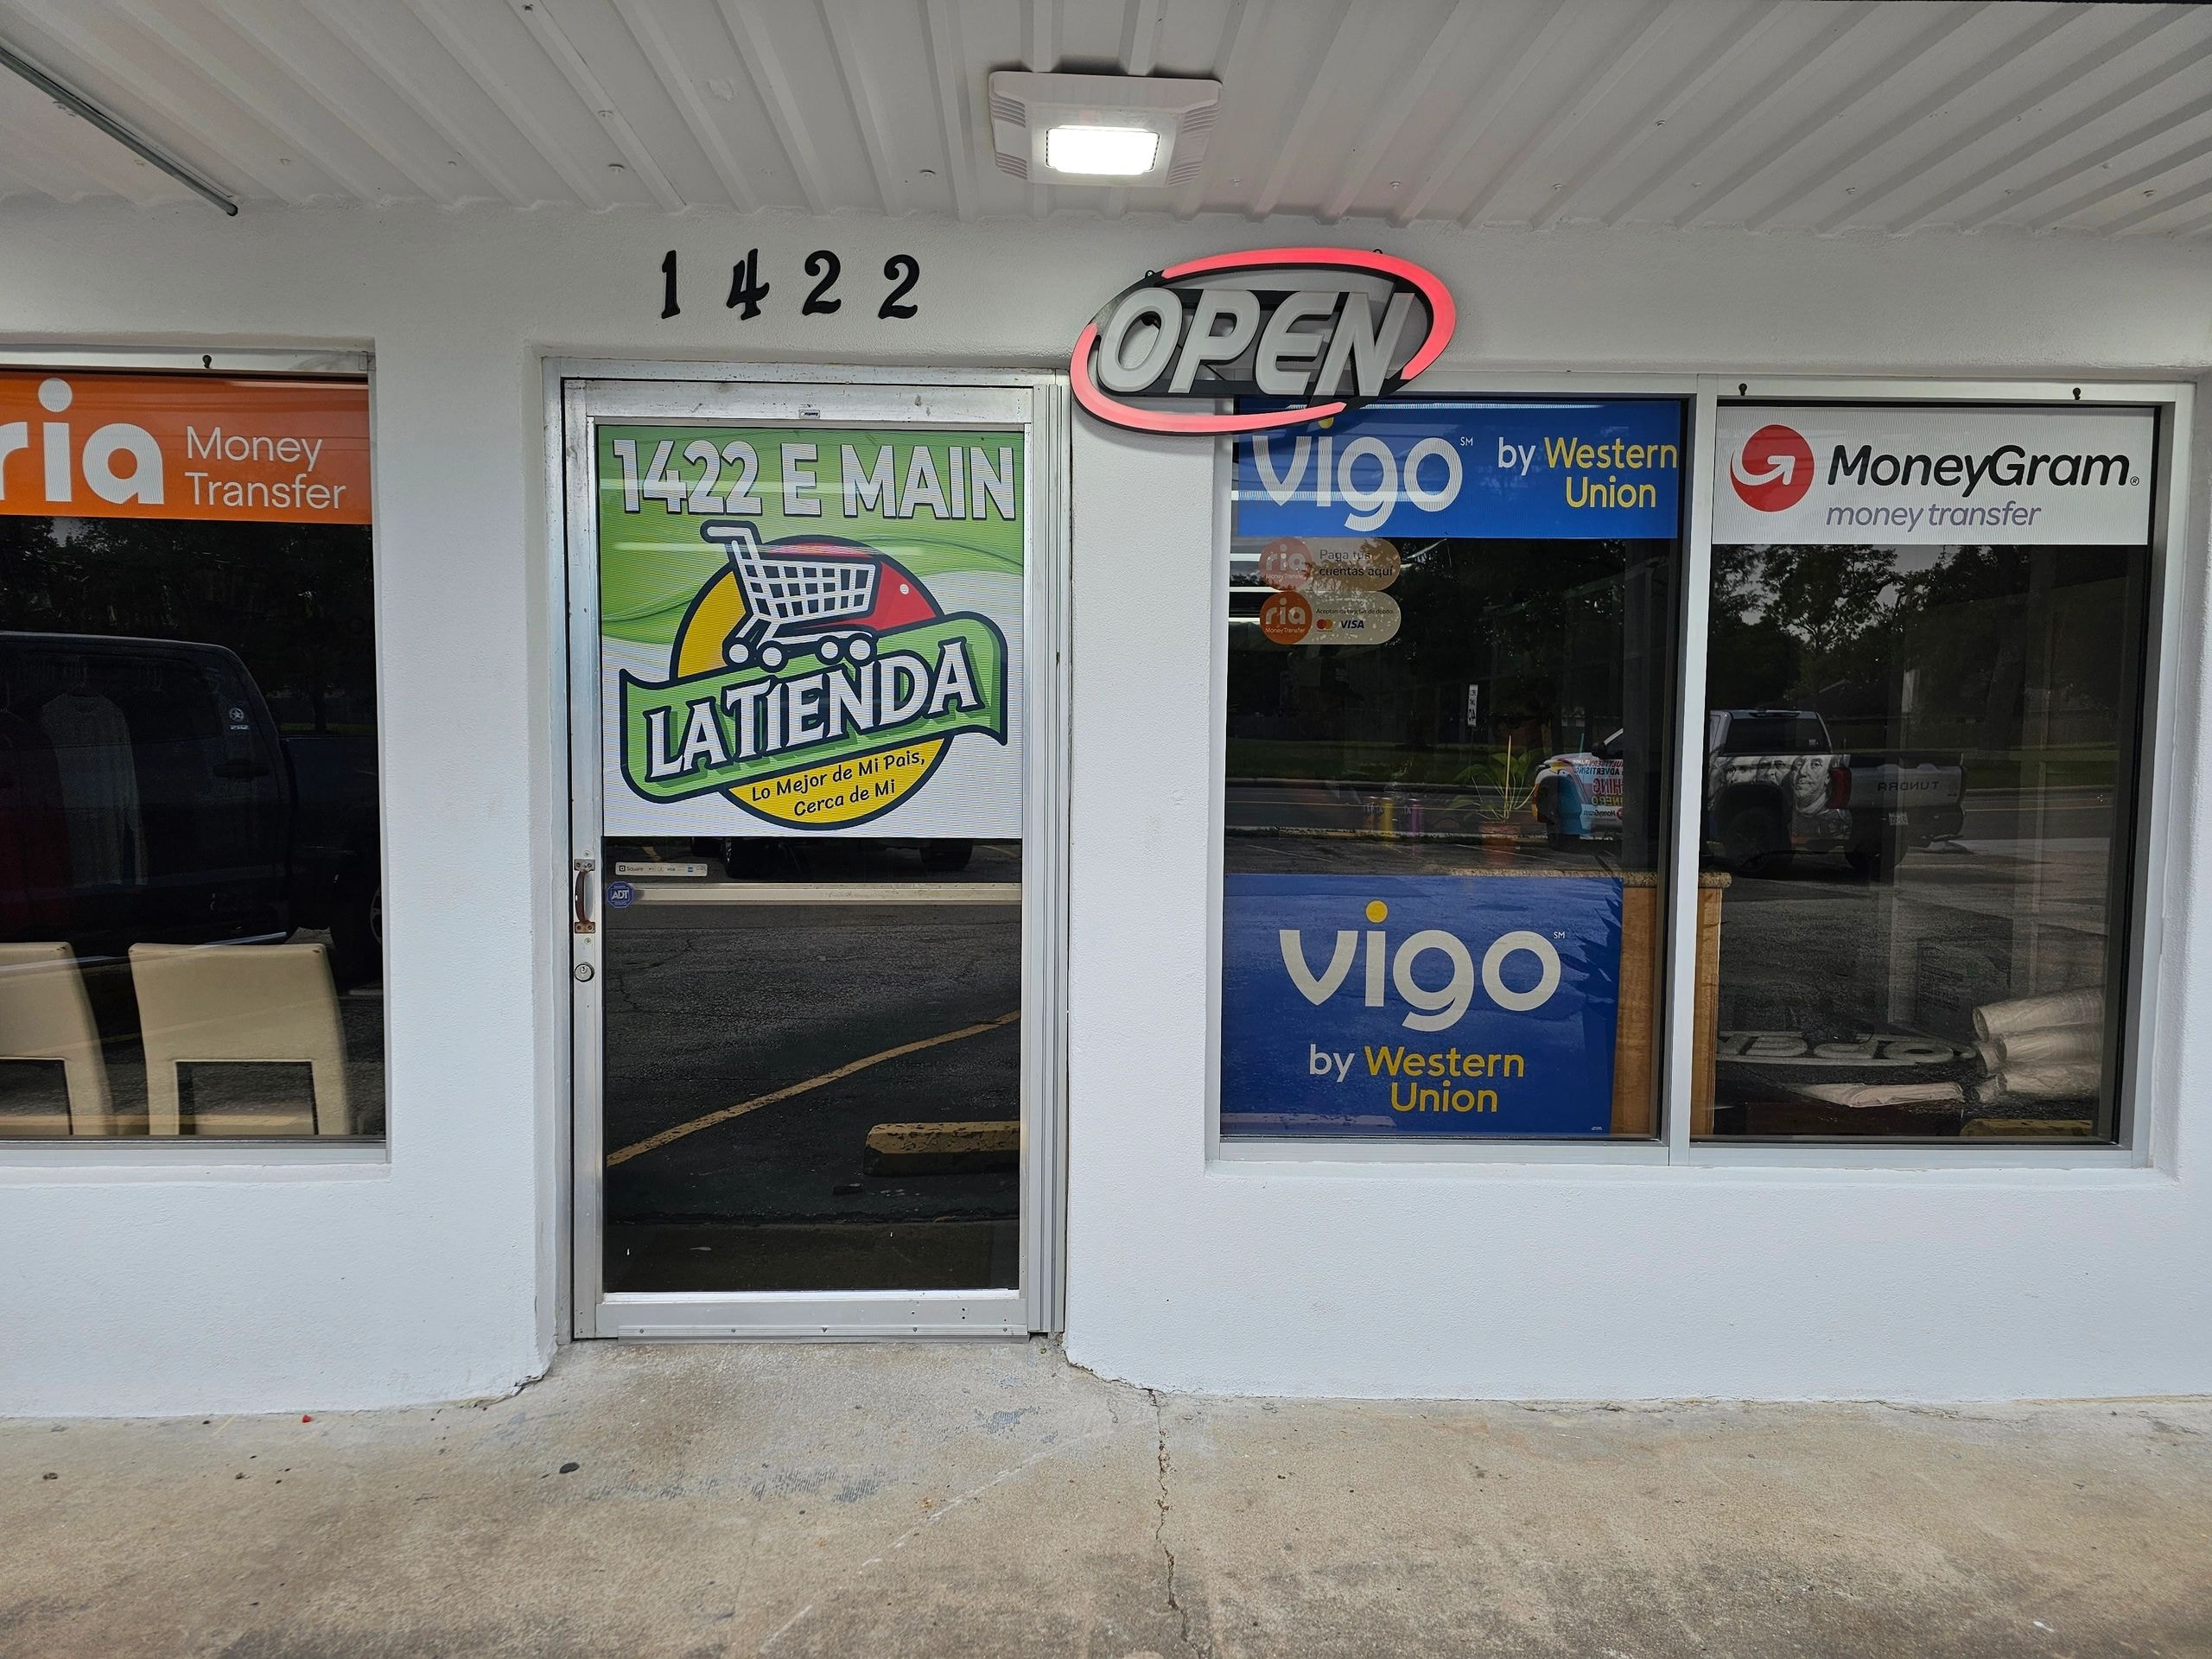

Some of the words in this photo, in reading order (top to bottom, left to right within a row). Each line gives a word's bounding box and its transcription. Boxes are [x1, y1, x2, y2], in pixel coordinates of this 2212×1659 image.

[1096, 286, 1416, 397] OPEN
[186, 426, 323, 472] Money
[1497, 436, 1536, 475] by
[1544, 436, 1678, 469] Western
[184, 472, 346, 509] Transfer
[613, 438, 763, 516] 1422
[779, 442, 822, 518] E
[840, 443, 1016, 520] MAIN
[1251, 416, 1464, 532] vigo
[1565, 475, 1657, 508] Union
[1826, 504, 1926, 532] money
[1929, 500, 2042, 526] transfer
[1265, 543, 1306, 571] ria
[1319, 549, 1349, 563] Paga
[1353, 550, 1371, 561] tus
[1319, 567, 1364, 576] cuentas
[1368, 566, 1394, 580] aquí
[1265, 597, 1306, 625] ria
[1340, 620, 1364, 629] VISA
[752, 786, 771, 802] Lo
[776, 773, 827, 794] Mejor
[832, 765, 852, 782] de
[858, 758, 879, 776] Mi
[793, 792, 844, 817] Cerca
[849, 785, 870, 803] de
[874, 779, 895, 798] Mi
[611, 890, 629, 899] ADT
[1279, 899, 1561, 1032] vigo
[1308, 1044, 1355, 1082] by
[1363, 1046, 1525, 1077] Western
[1390, 1080, 1498, 1113] Union
